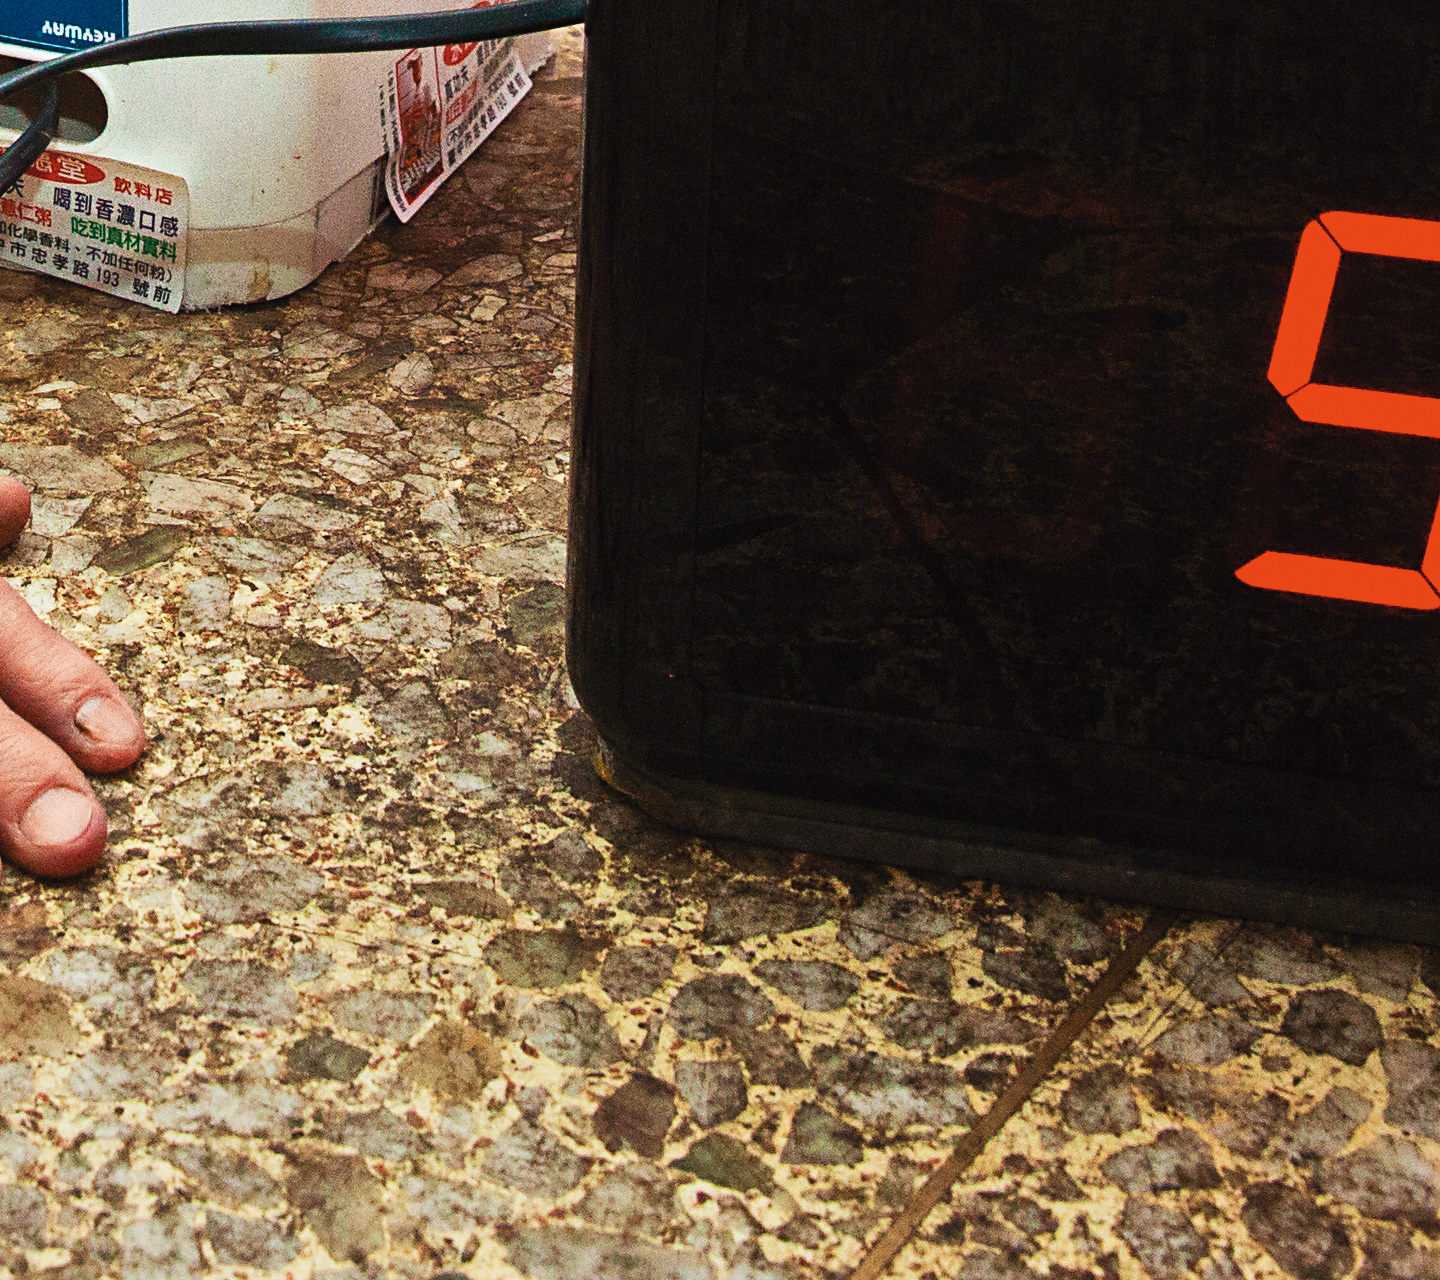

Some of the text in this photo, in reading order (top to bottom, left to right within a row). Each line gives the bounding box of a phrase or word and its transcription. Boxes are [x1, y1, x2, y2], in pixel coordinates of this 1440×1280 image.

[42, 20, 116, 44] KEYWAY
[114, 176, 173, 206] 飲料店
[53, 187, 179, 238] 喝到香濃口感
[70, 216, 177, 263] 吃到真材實料
